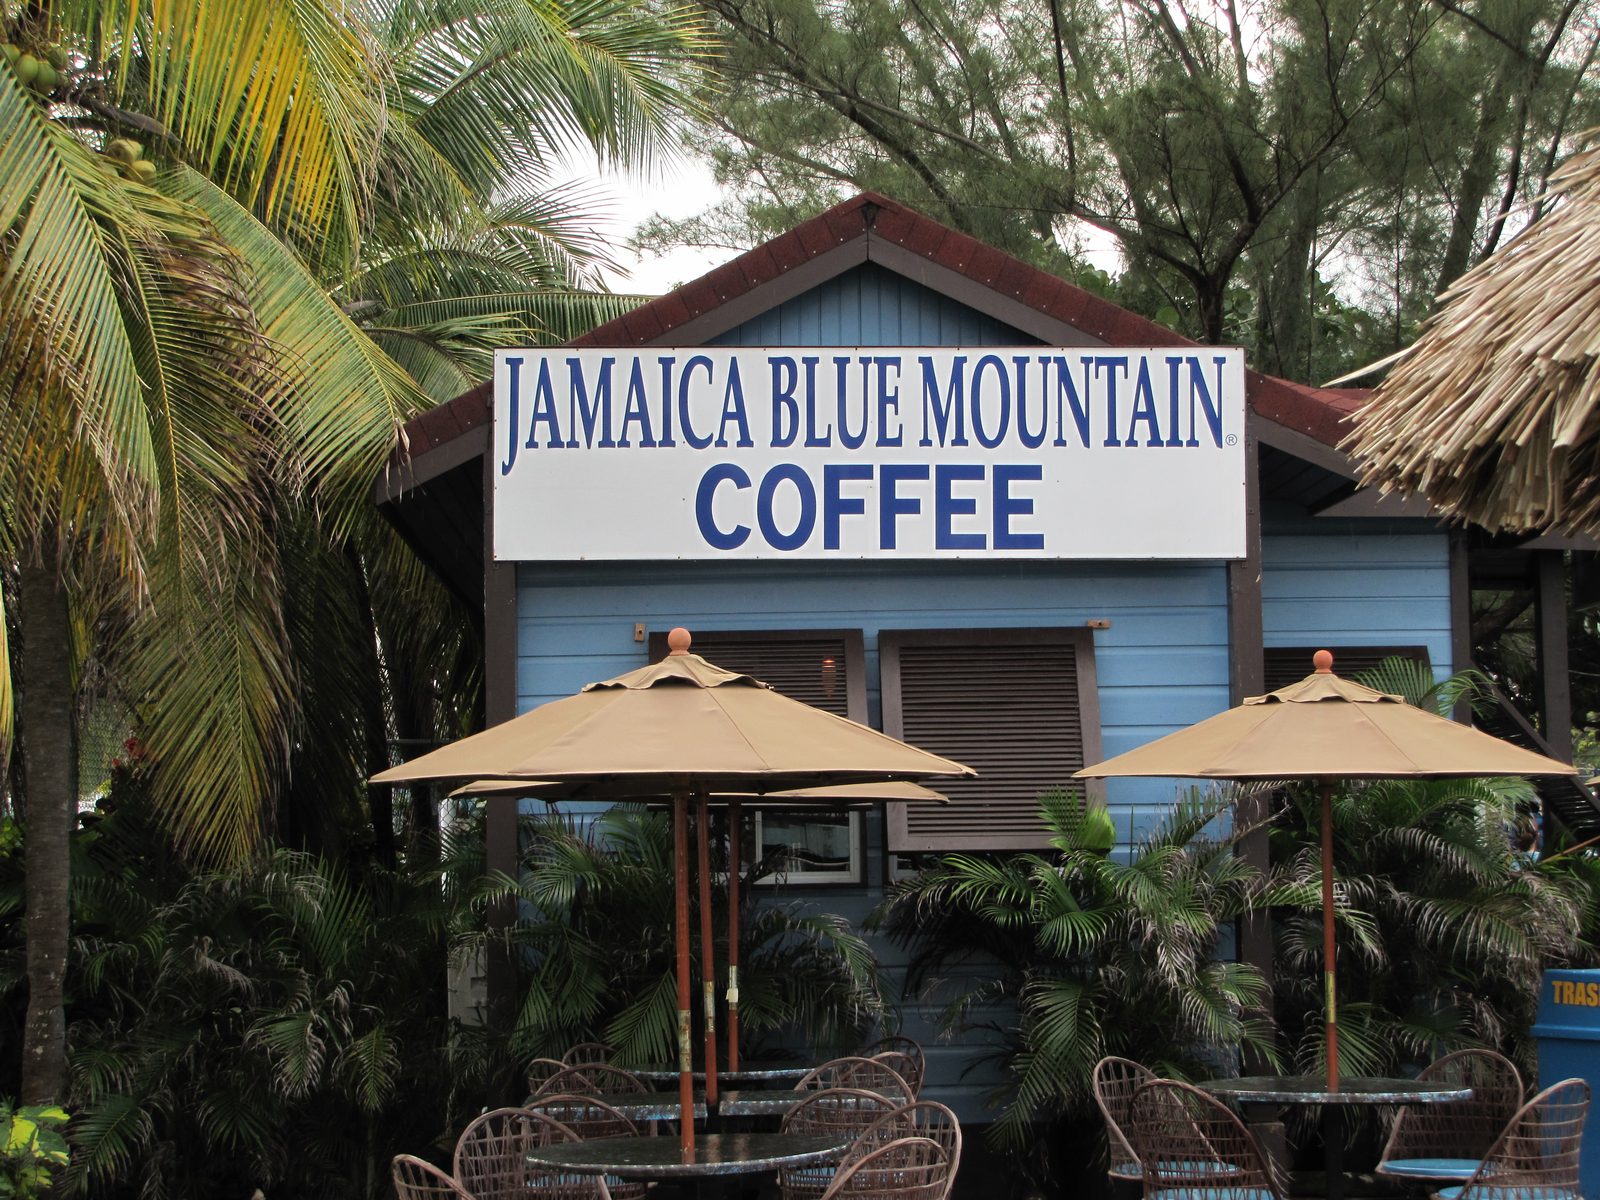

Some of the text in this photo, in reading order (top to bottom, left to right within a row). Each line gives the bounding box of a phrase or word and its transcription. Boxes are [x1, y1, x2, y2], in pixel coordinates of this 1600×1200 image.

[502, 356, 754, 476] JAMAICA
[767, 356, 903, 450] BLUE
[917, 355, 1227, 449] MOUNTAIN
[695, 463, 1045, 551] COFFEE
[1552, 981, 1600, 1007] TRAS
